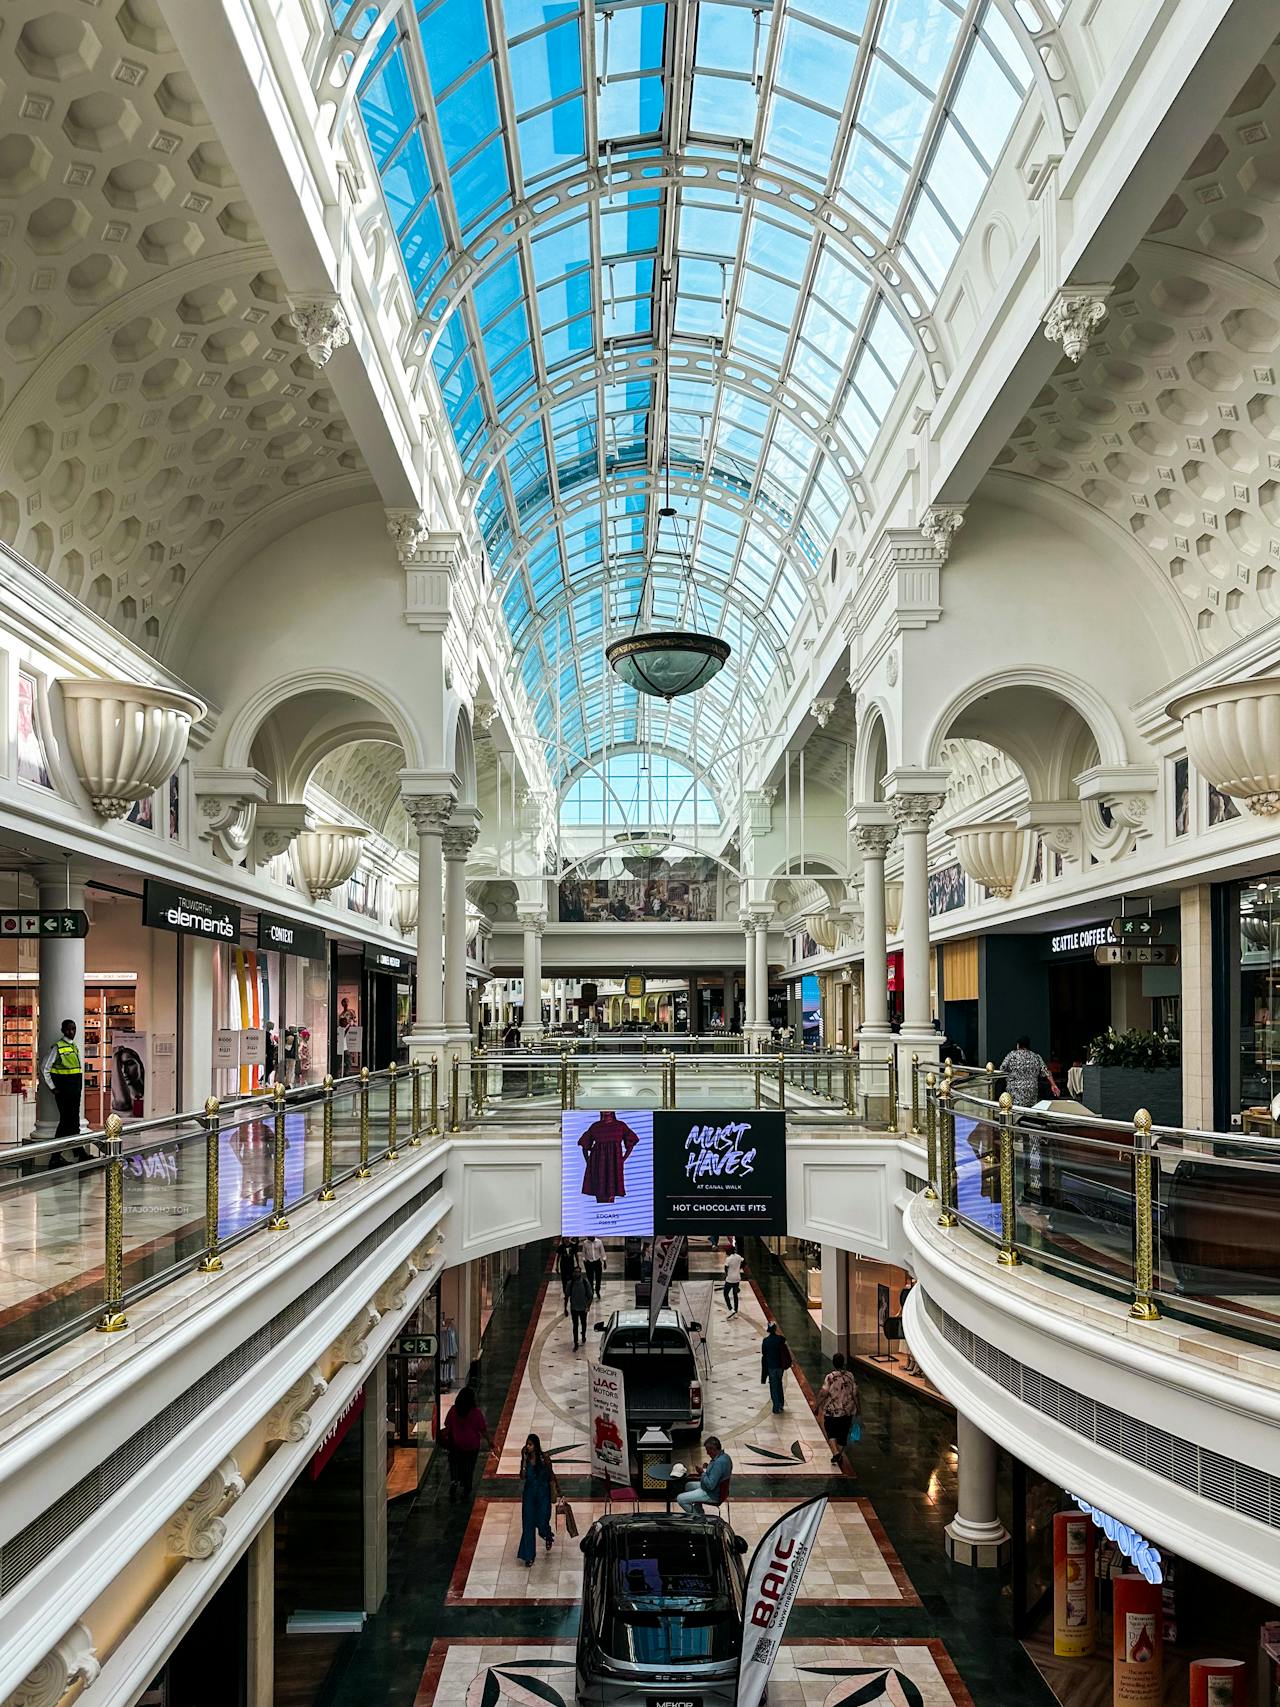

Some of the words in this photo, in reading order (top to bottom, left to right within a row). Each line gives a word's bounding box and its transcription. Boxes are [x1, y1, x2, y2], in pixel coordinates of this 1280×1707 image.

[167, 907, 234, 937] elements
[270, 925, 294, 944] CONTEXT
[1051, 932, 1079, 953] SEATTLE
[1080, 927, 1106, 948] COFFEE
[684, 1121, 752, 1151] MUST
[684, 1146, 757, 1183] HAVES
[672, 1204, 691, 1212] HOT
[693, 1204, 745, 1212] CHOCOLATE
[748, 1204, 767, 1212] FITS
[593, 1365, 618, 1377] MEKOR
[593, 1378, 618, 1391] JAC
[593, 1386, 619, 1399] MOTORS
[750, 1535, 796, 1629] BAIC
